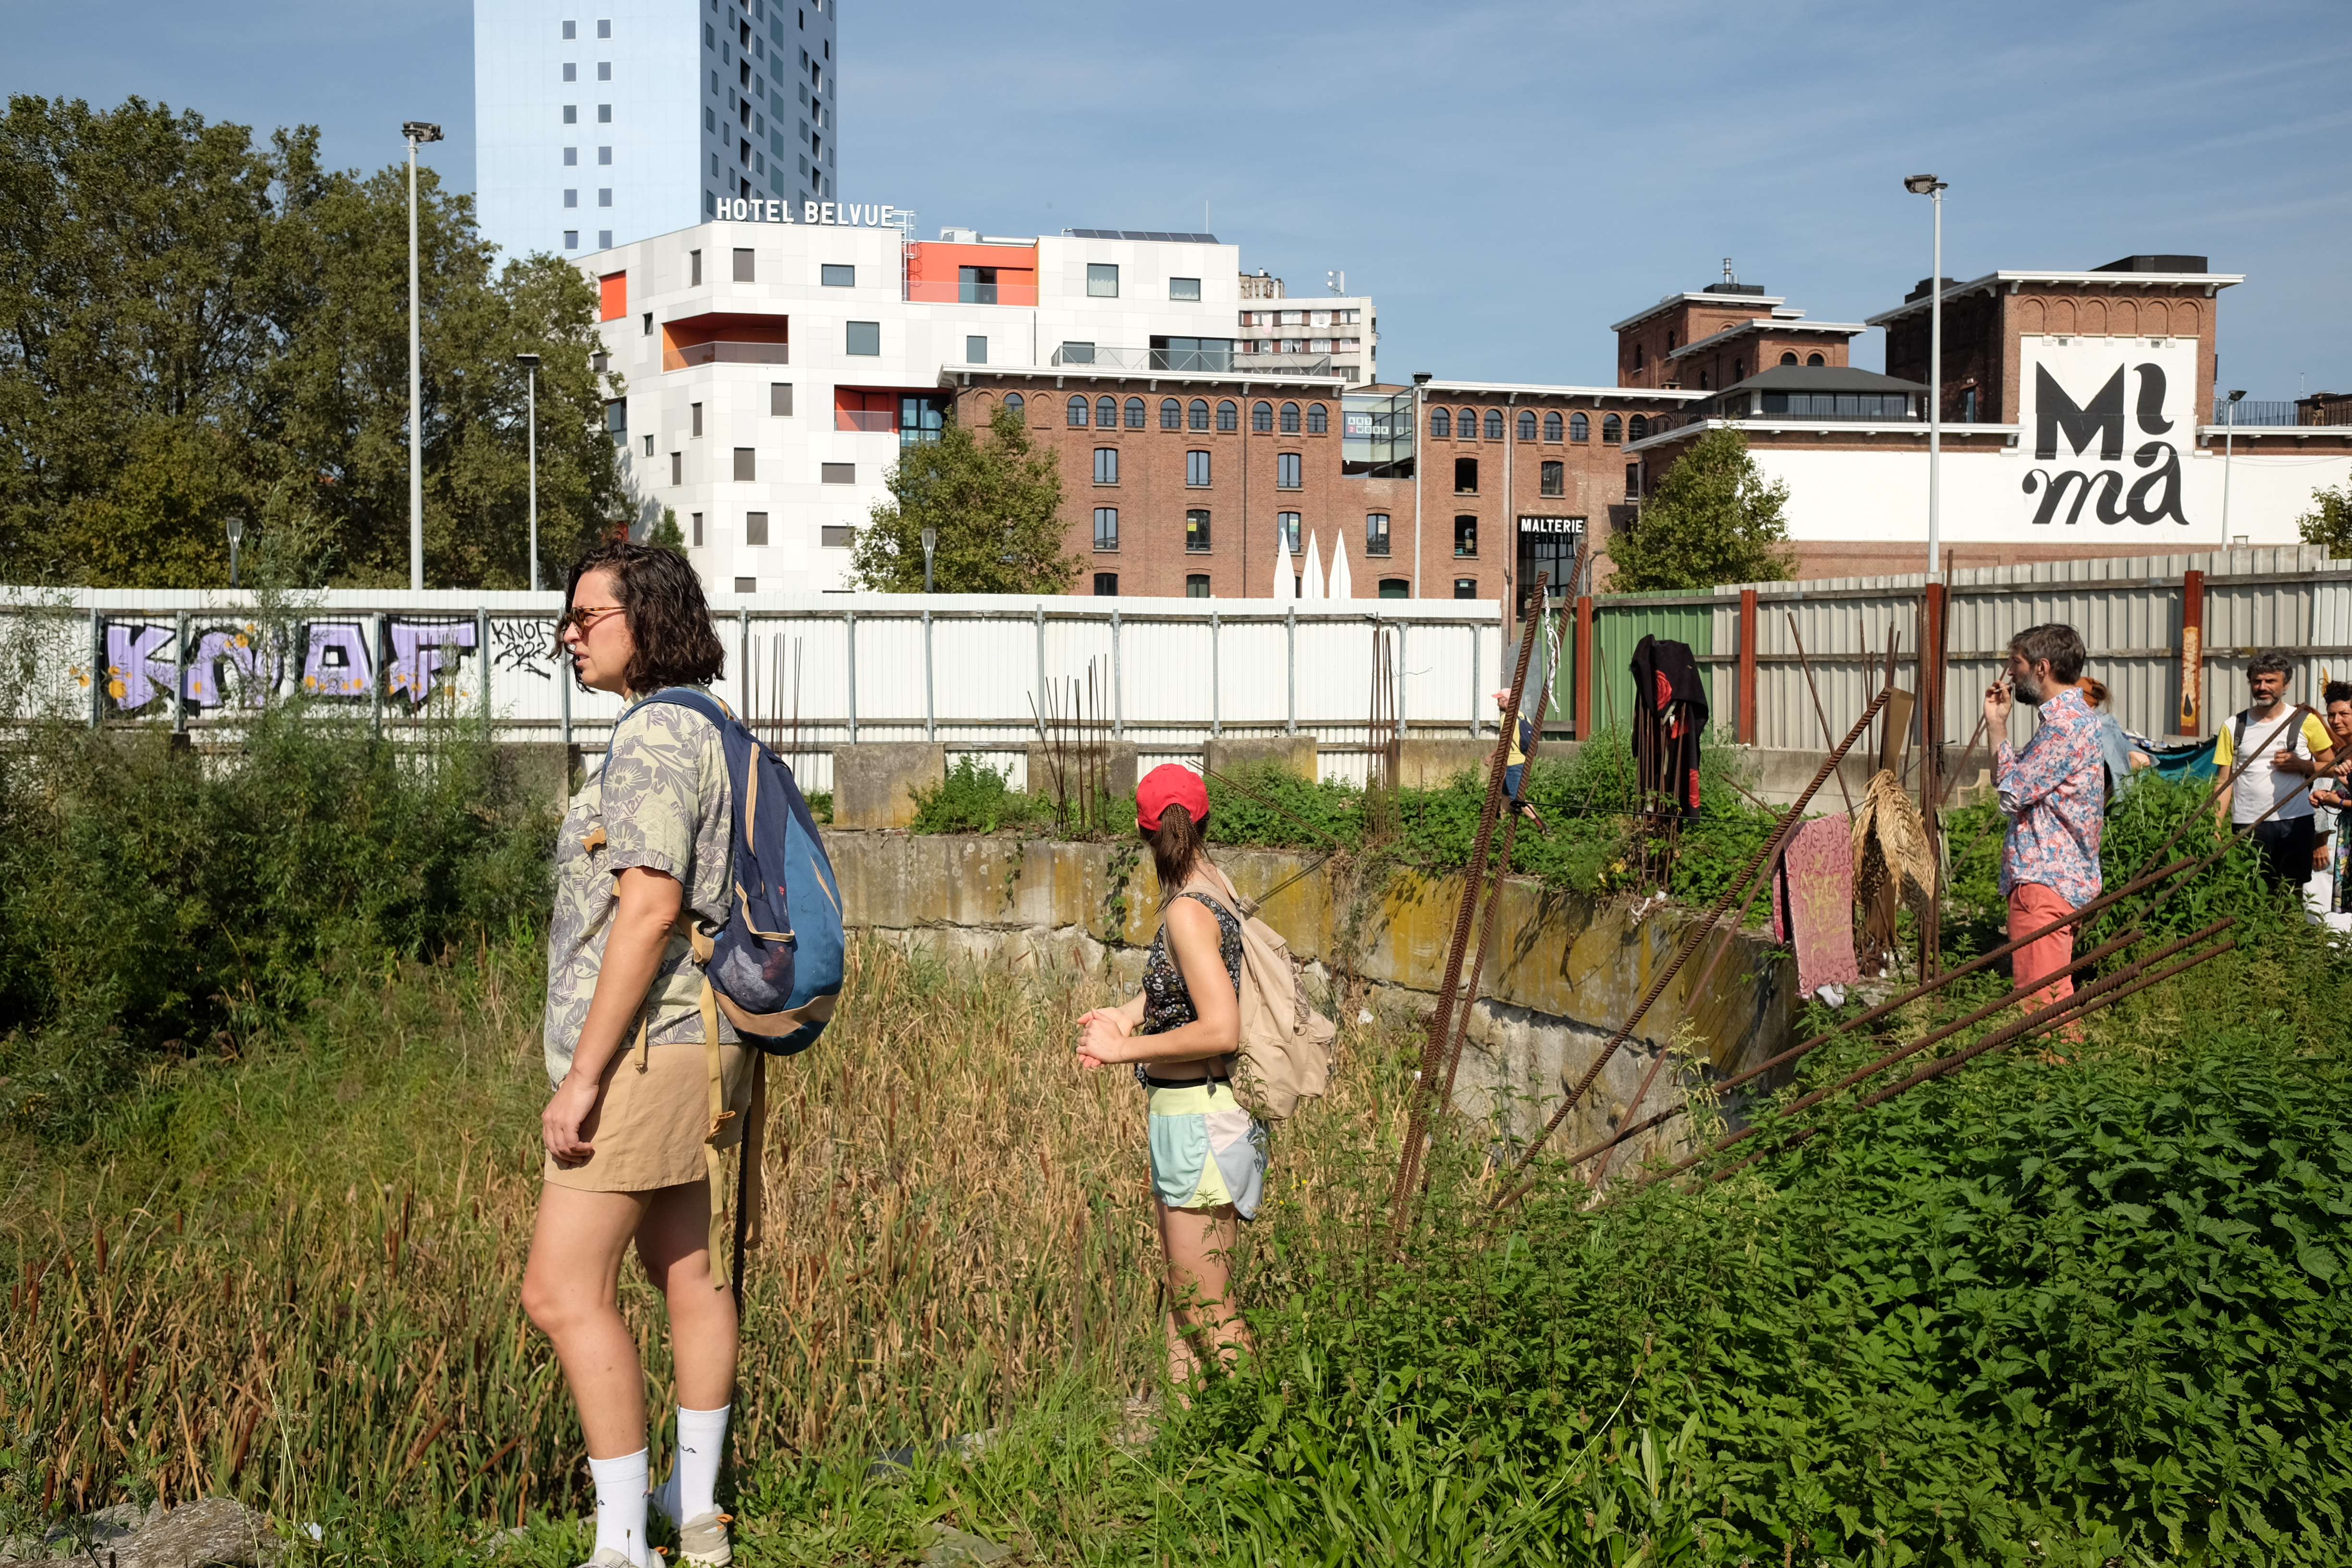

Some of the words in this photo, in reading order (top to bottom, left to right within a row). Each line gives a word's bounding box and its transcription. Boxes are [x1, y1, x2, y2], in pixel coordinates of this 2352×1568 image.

[716, 197, 795, 223] HOTEL
[804, 200, 895, 228] BELVUE
[2021, 441, 2190, 525] ma
[1521, 518, 1583, 533] MALTERIE
